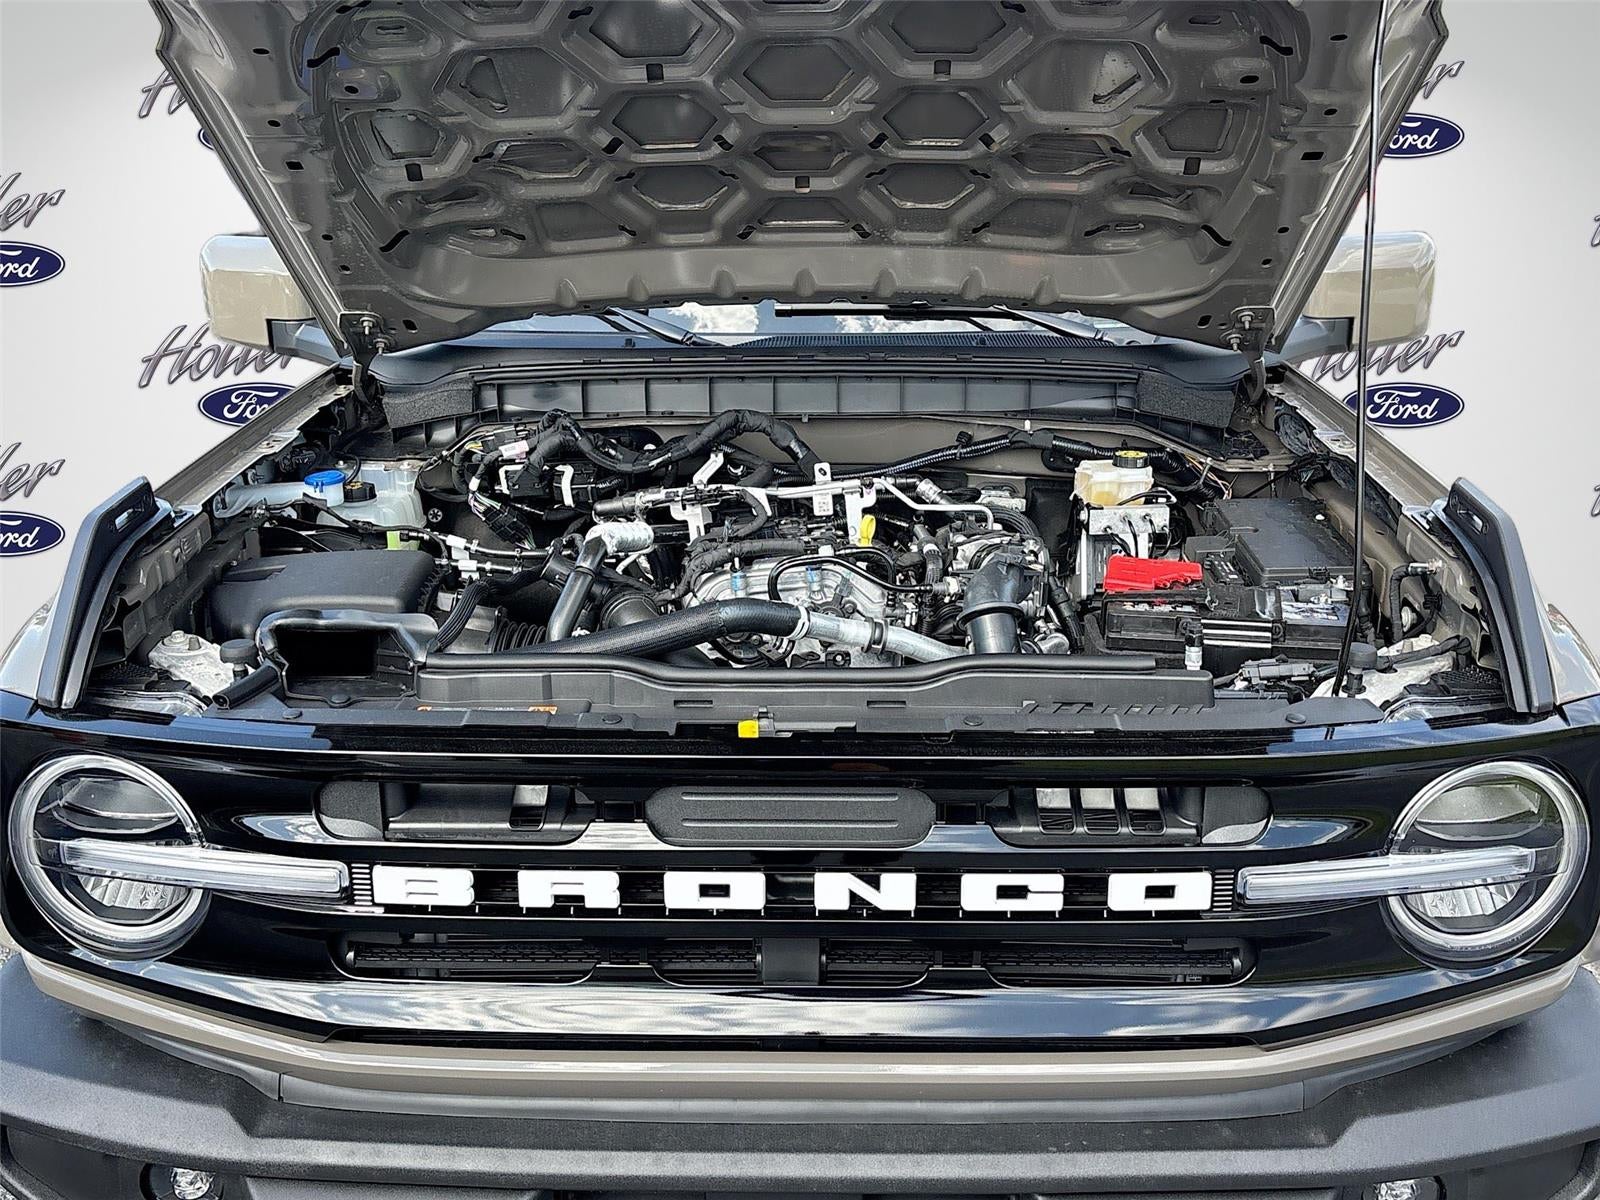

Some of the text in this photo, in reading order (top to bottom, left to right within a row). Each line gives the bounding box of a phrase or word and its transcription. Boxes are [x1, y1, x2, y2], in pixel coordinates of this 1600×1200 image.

[1388, 121, 1440, 150] ord
[0, 172, 66, 231] ler
[1366, 389, 1440, 420] Ford
[0, 442, 66, 501] ler
[372, 865, 1213, 912] BRONCO
